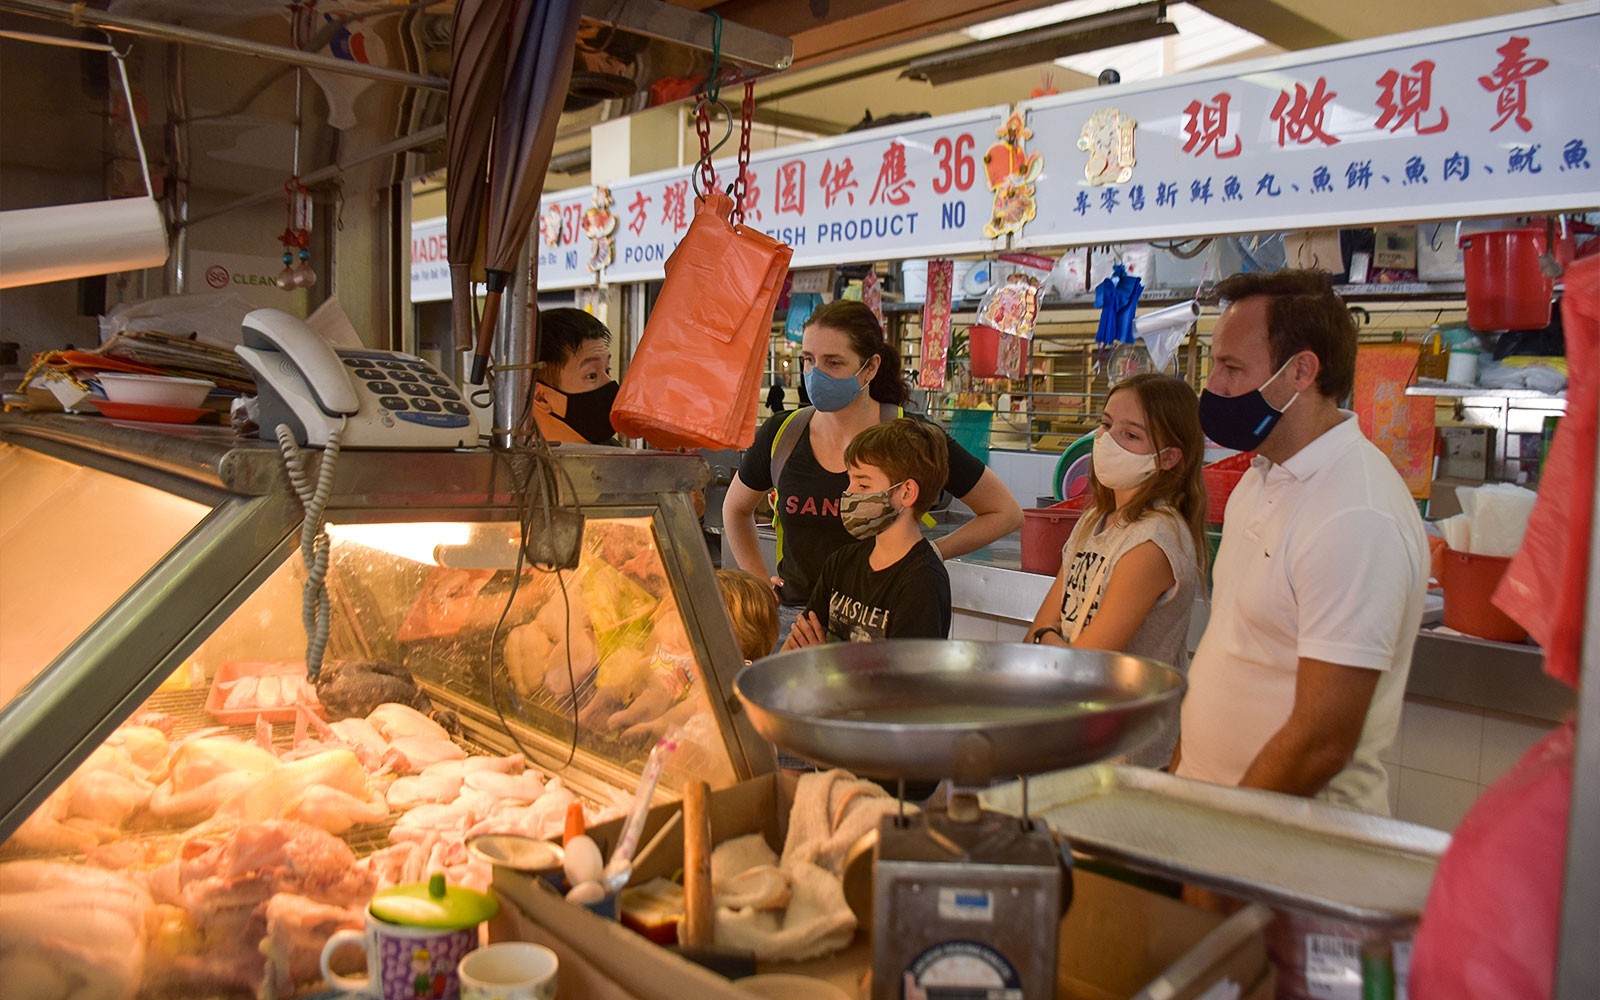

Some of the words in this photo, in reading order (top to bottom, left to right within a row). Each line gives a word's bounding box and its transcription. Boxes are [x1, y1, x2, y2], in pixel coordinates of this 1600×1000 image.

[1181, 36, 1549, 159] 現做現賣
[932, 132, 976, 195] 36
[562, 203, 582, 246] 37
[941, 200, 966, 230] NO
[625, 243, 665, 264] POON
[818, 212, 919, 243] PRODUCT
[565, 249, 578, 270] NO
[232, 273, 277, 288] CLEAN
[785, 495, 840, 517] SAN
